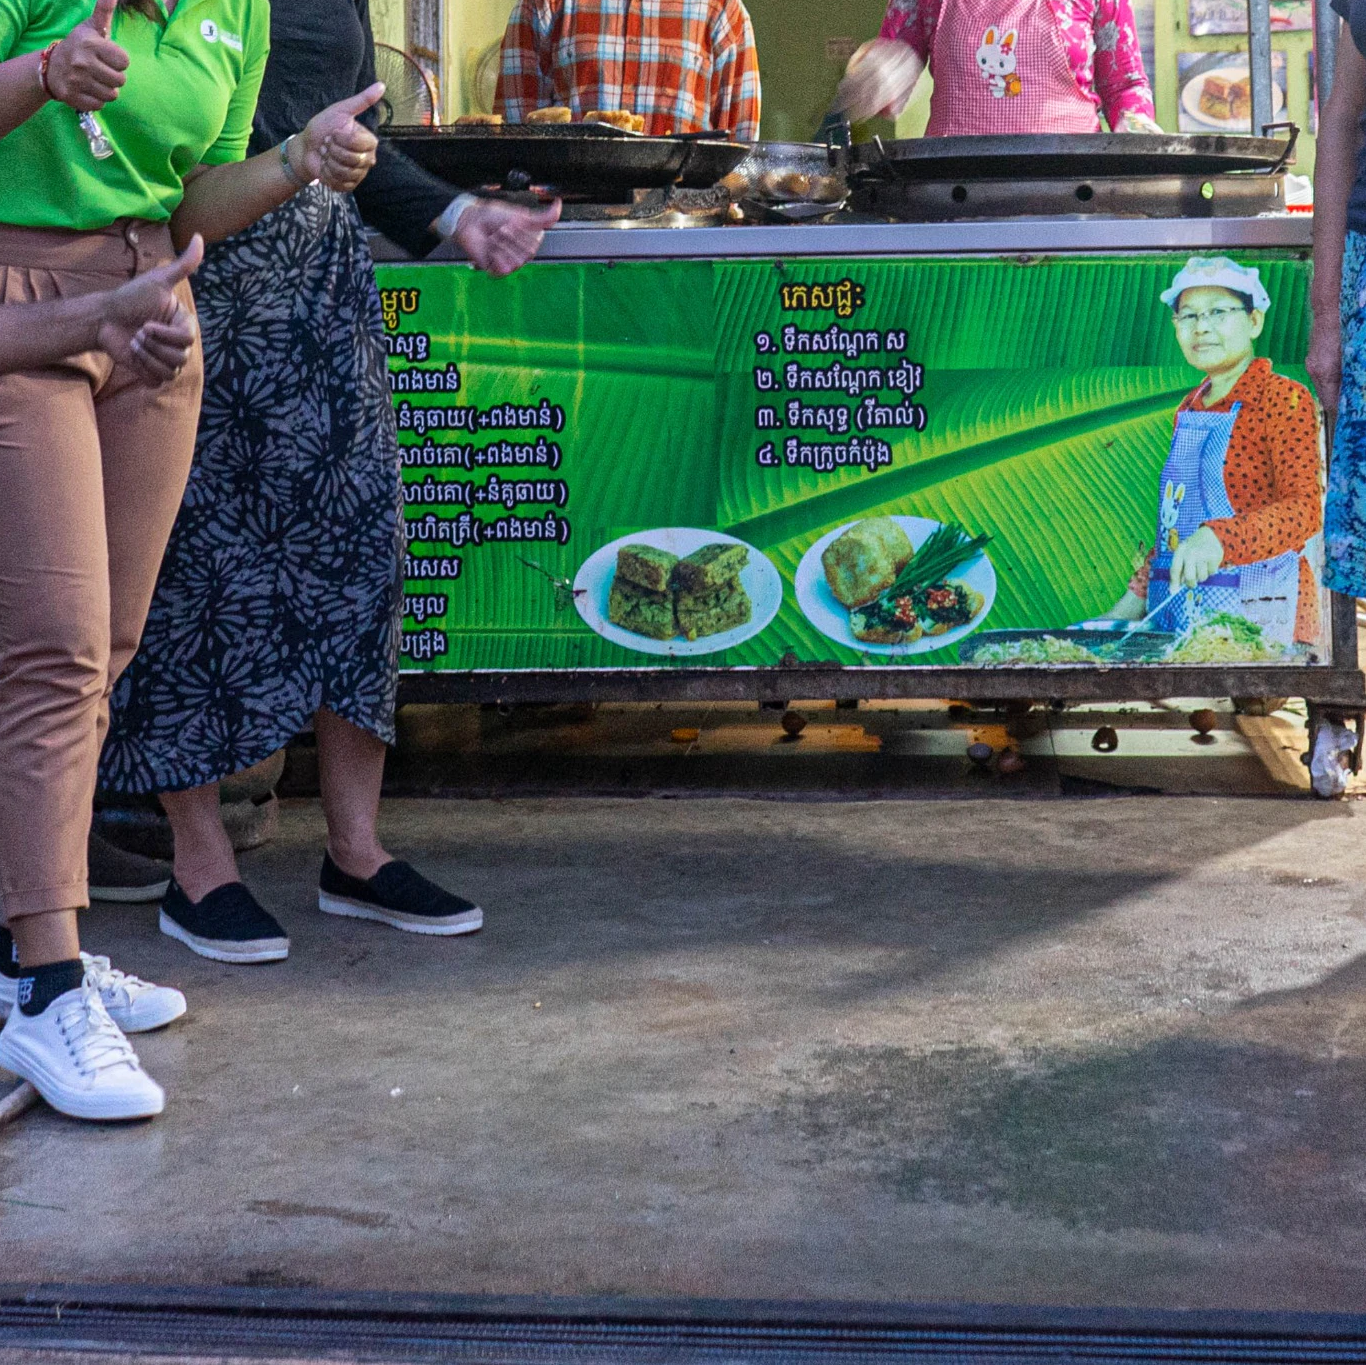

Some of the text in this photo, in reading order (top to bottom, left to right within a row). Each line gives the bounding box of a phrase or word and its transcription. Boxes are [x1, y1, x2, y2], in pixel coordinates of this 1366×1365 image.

[385, 335, 427, 360] ាសុទ្ធ
[388, 366, 458, 390] ាពងមាន់
